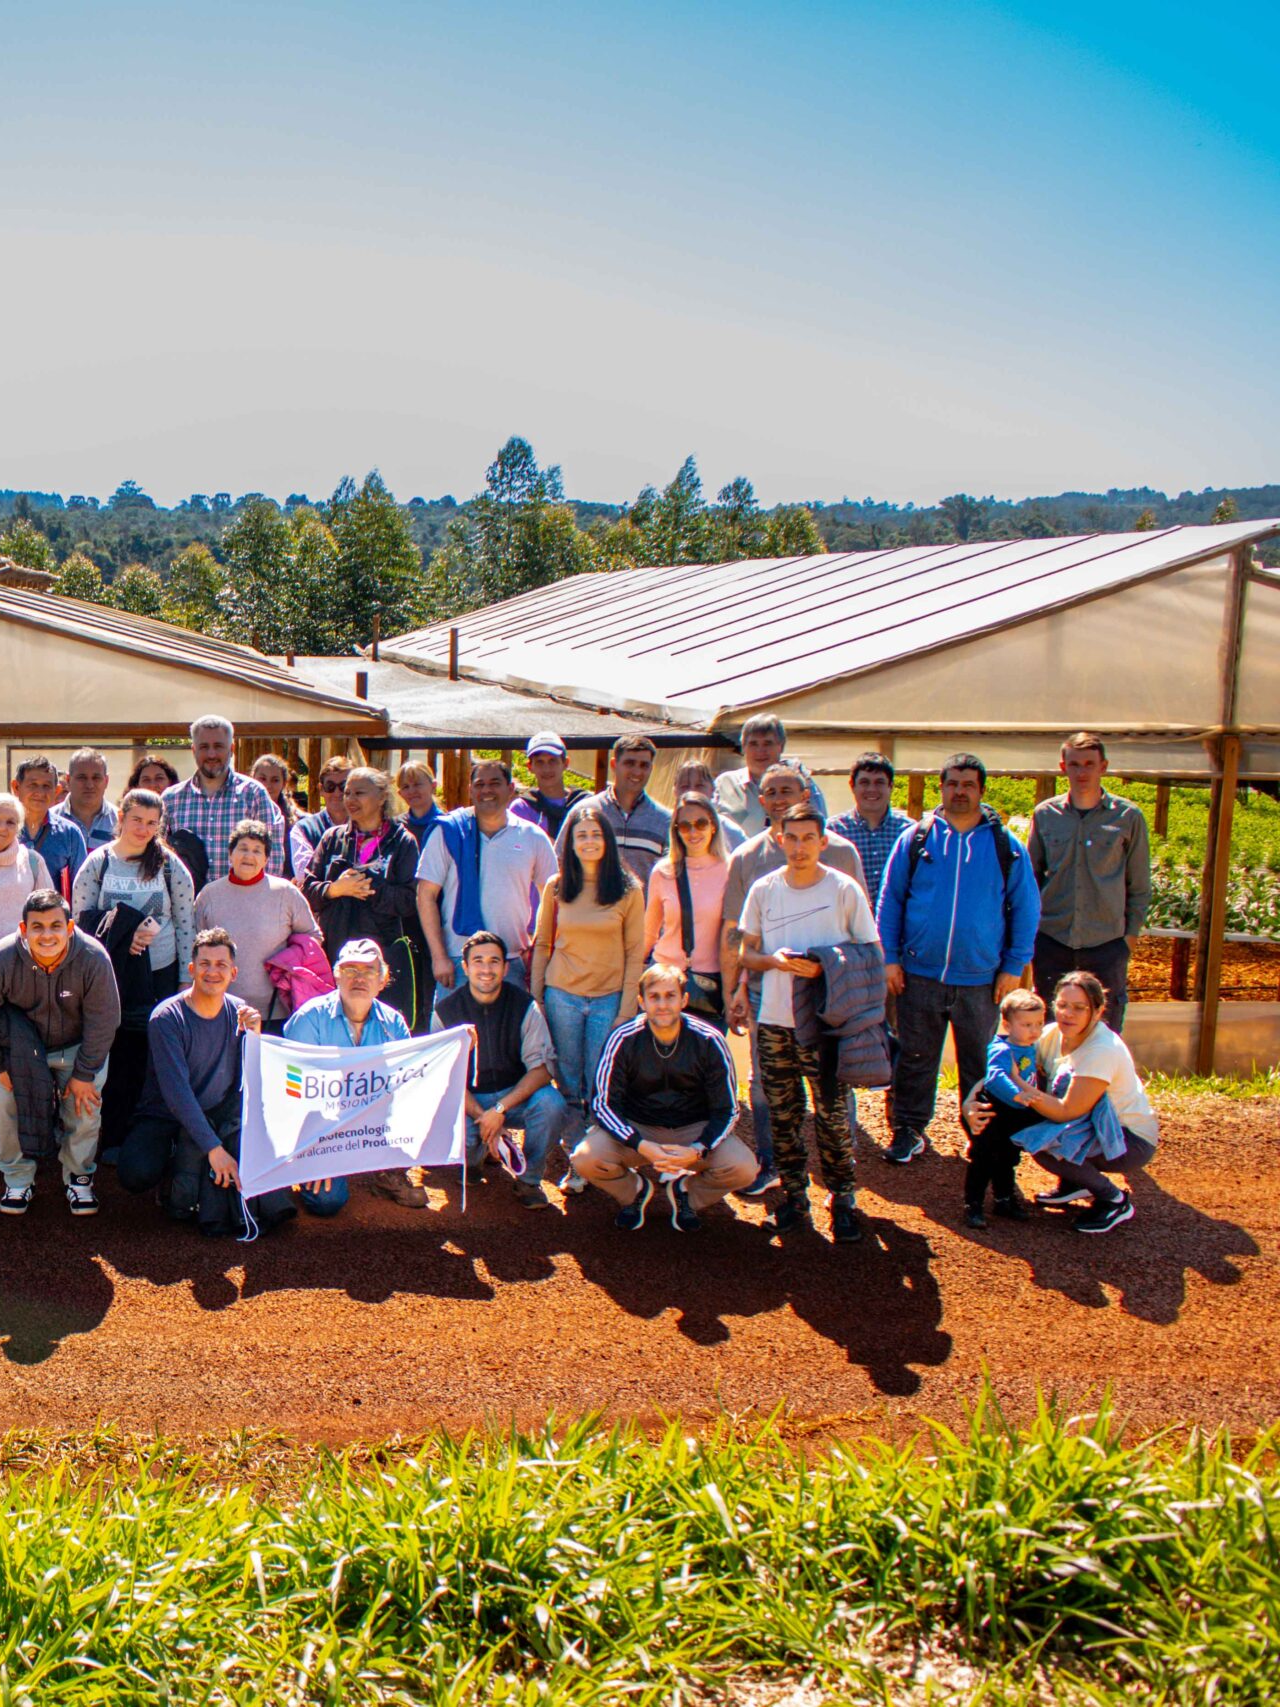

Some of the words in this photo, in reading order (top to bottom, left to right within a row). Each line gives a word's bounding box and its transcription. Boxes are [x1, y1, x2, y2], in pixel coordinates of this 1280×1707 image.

[103, 876, 131, 891] NEW
[307, 1144, 343, 1157] alcance
[345, 1139, 360, 1151] del
[362, 1136, 415, 1149] Productor
